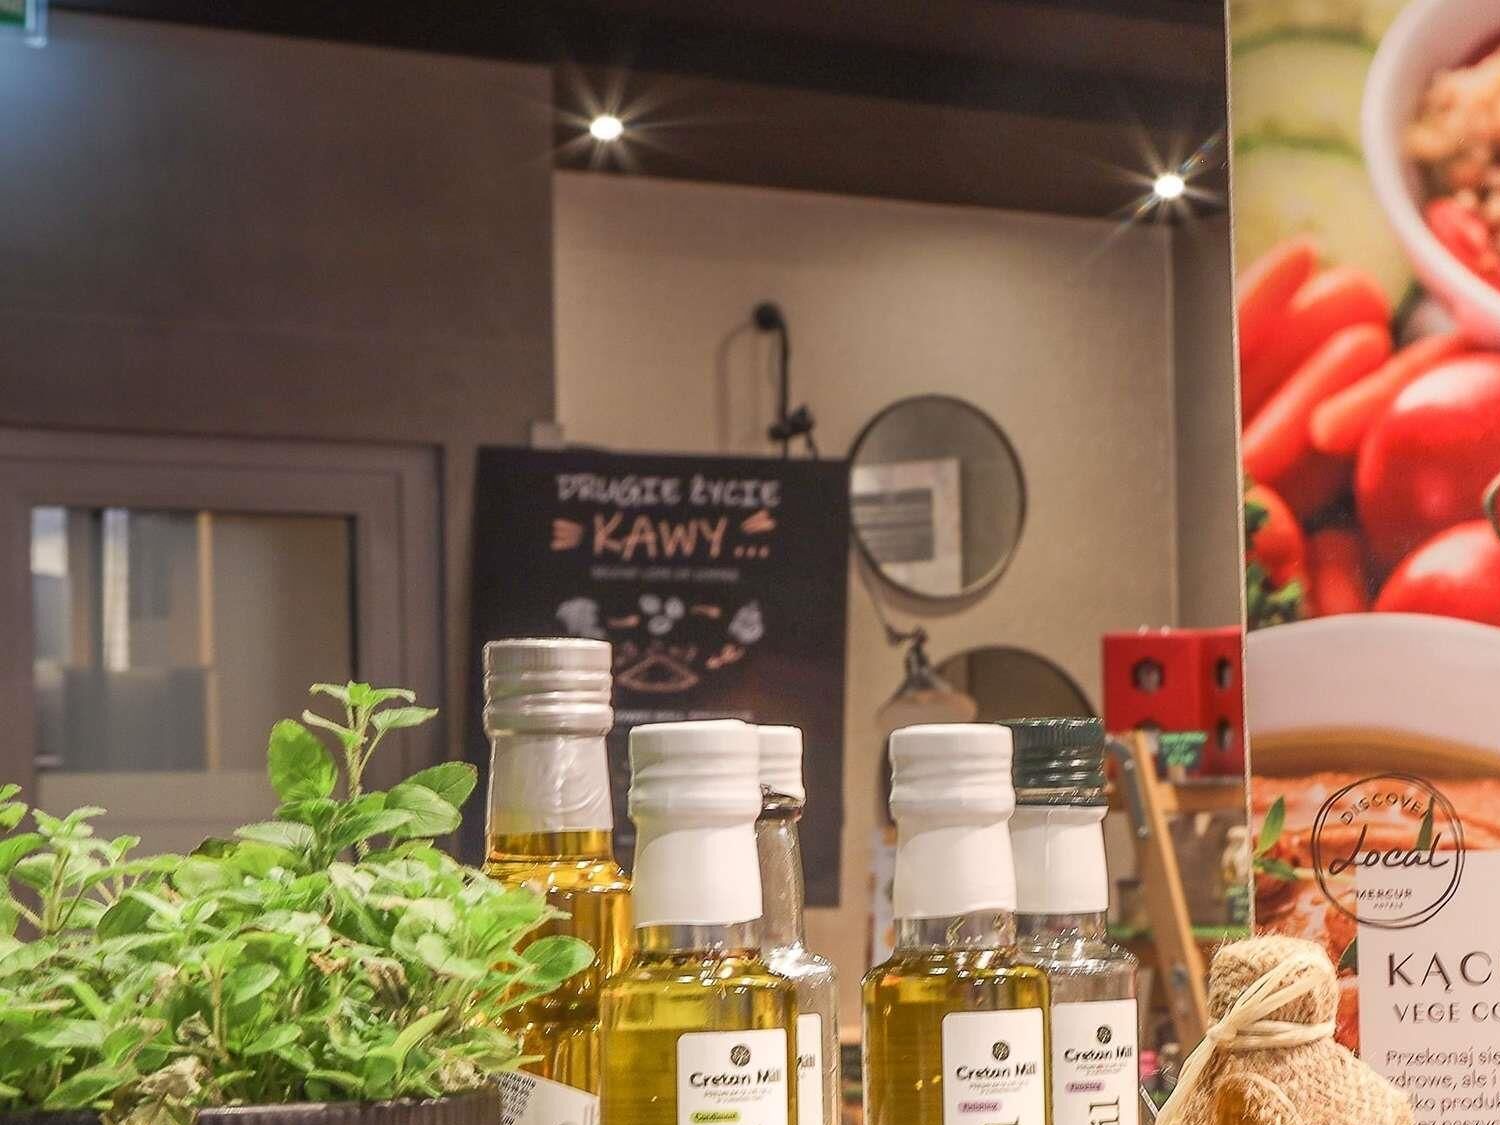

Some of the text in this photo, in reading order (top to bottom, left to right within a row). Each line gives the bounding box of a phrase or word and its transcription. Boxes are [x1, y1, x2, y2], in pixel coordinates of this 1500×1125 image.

[557, 474, 680, 506] DRUGIE
[1329, 823, 1449, 875] Local
[1393, 1001, 1461, 1024] VEGE
[1386, 1046, 1473, 1067] Przekonaj
[1462, 1069, 1488, 1089] ale
